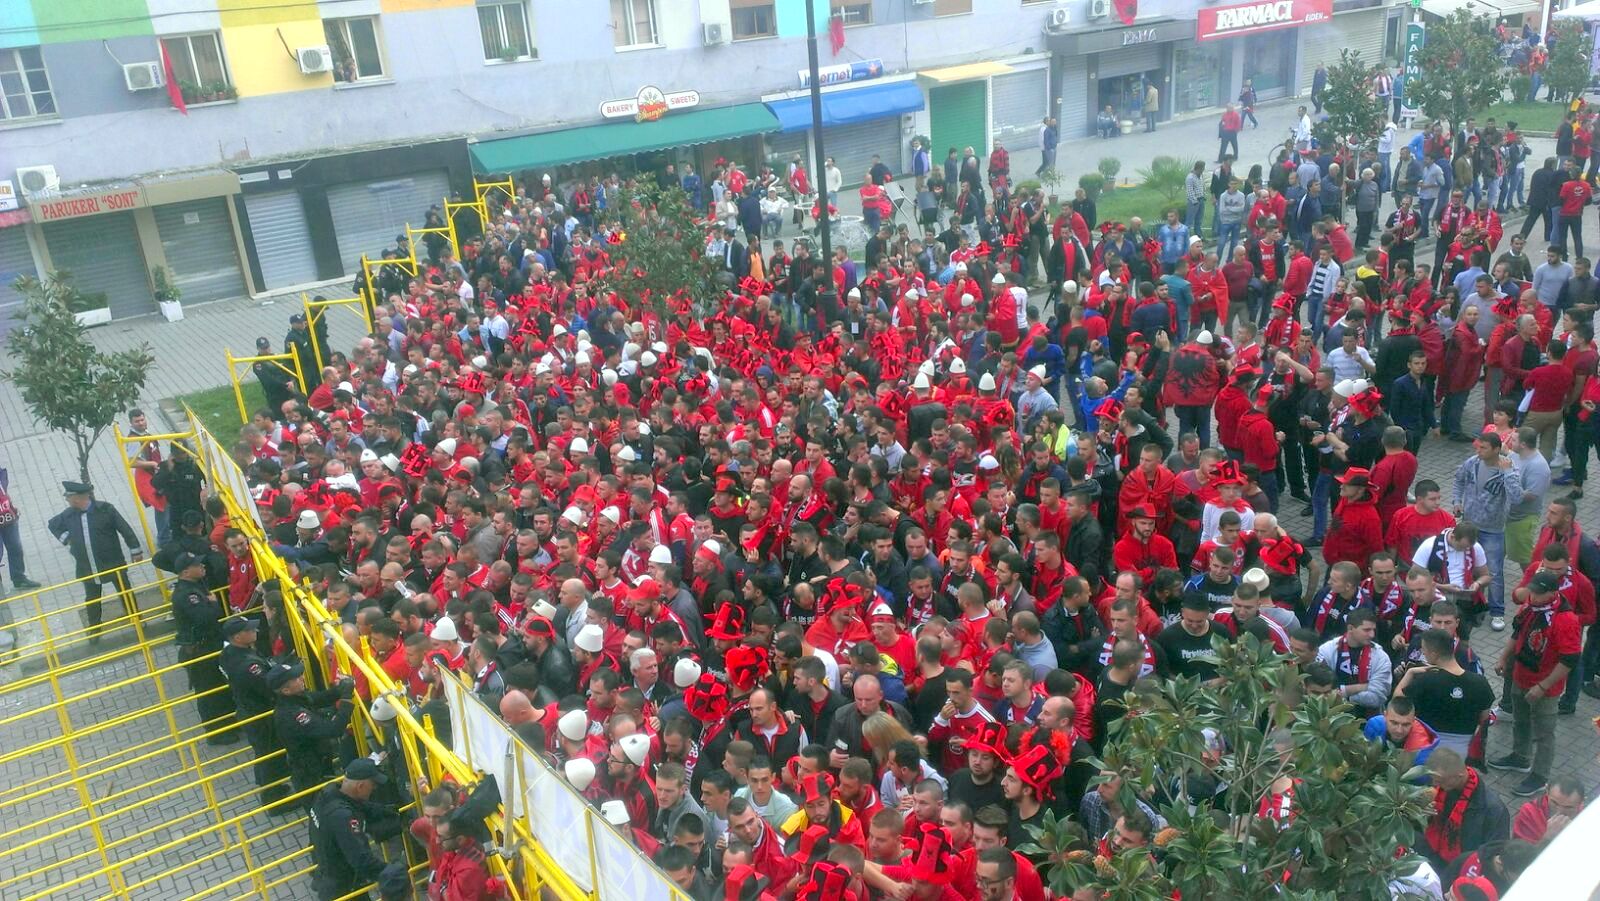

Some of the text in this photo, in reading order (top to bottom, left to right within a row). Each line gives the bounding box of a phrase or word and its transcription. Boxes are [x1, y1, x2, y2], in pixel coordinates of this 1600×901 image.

[1216, 1, 1294, 30] FARMACI
[804, 68, 850, 86] Iernet
[1406, 33, 1420, 106] FARMAI
[607, 95, 696, 114] BAKERY SWEETS
[41, 197, 101, 220] PARUKERI
